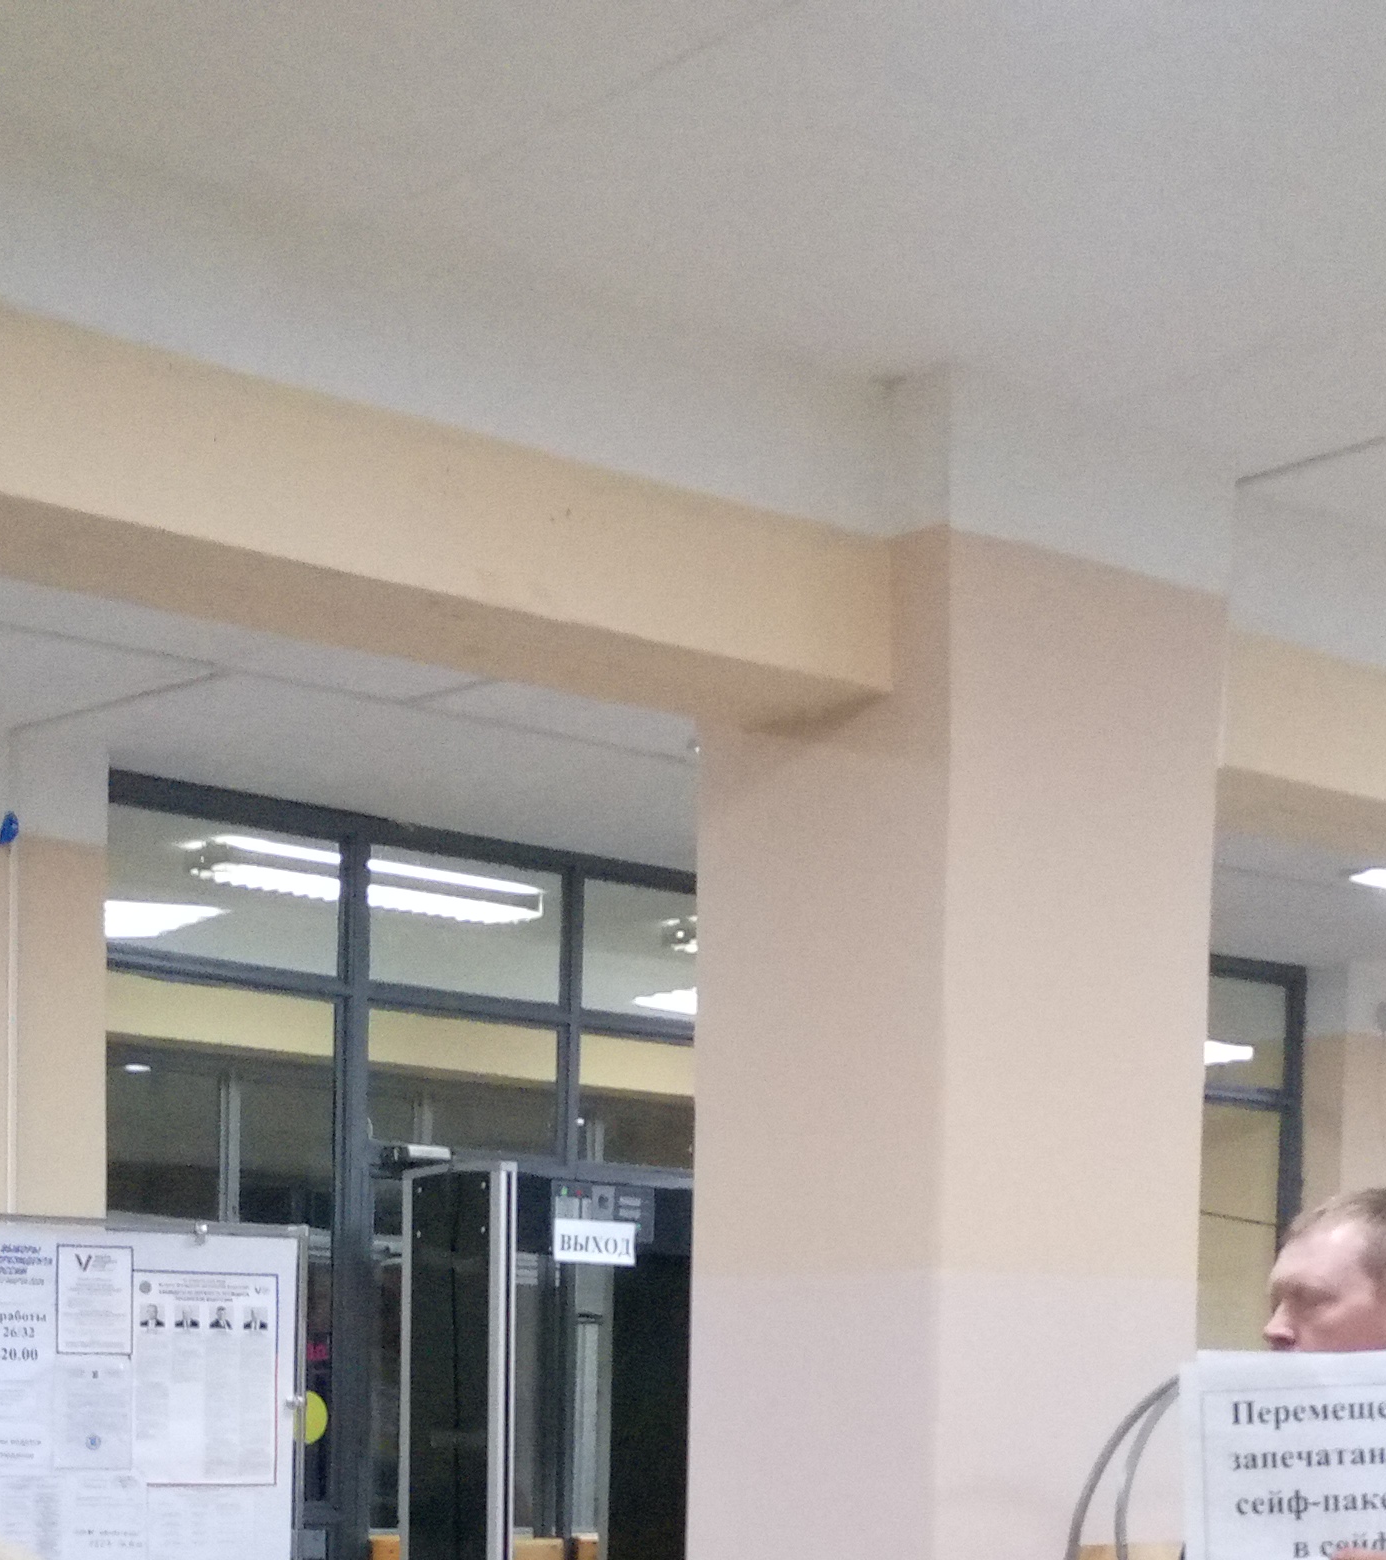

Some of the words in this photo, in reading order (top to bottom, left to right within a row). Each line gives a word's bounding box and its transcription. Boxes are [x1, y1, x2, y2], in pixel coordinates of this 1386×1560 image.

[560, 1234, 631, 1257] ВЫХОД
[0, 1310, 47, 1324] работы
[1294, 1541, 1309, 1558] в
